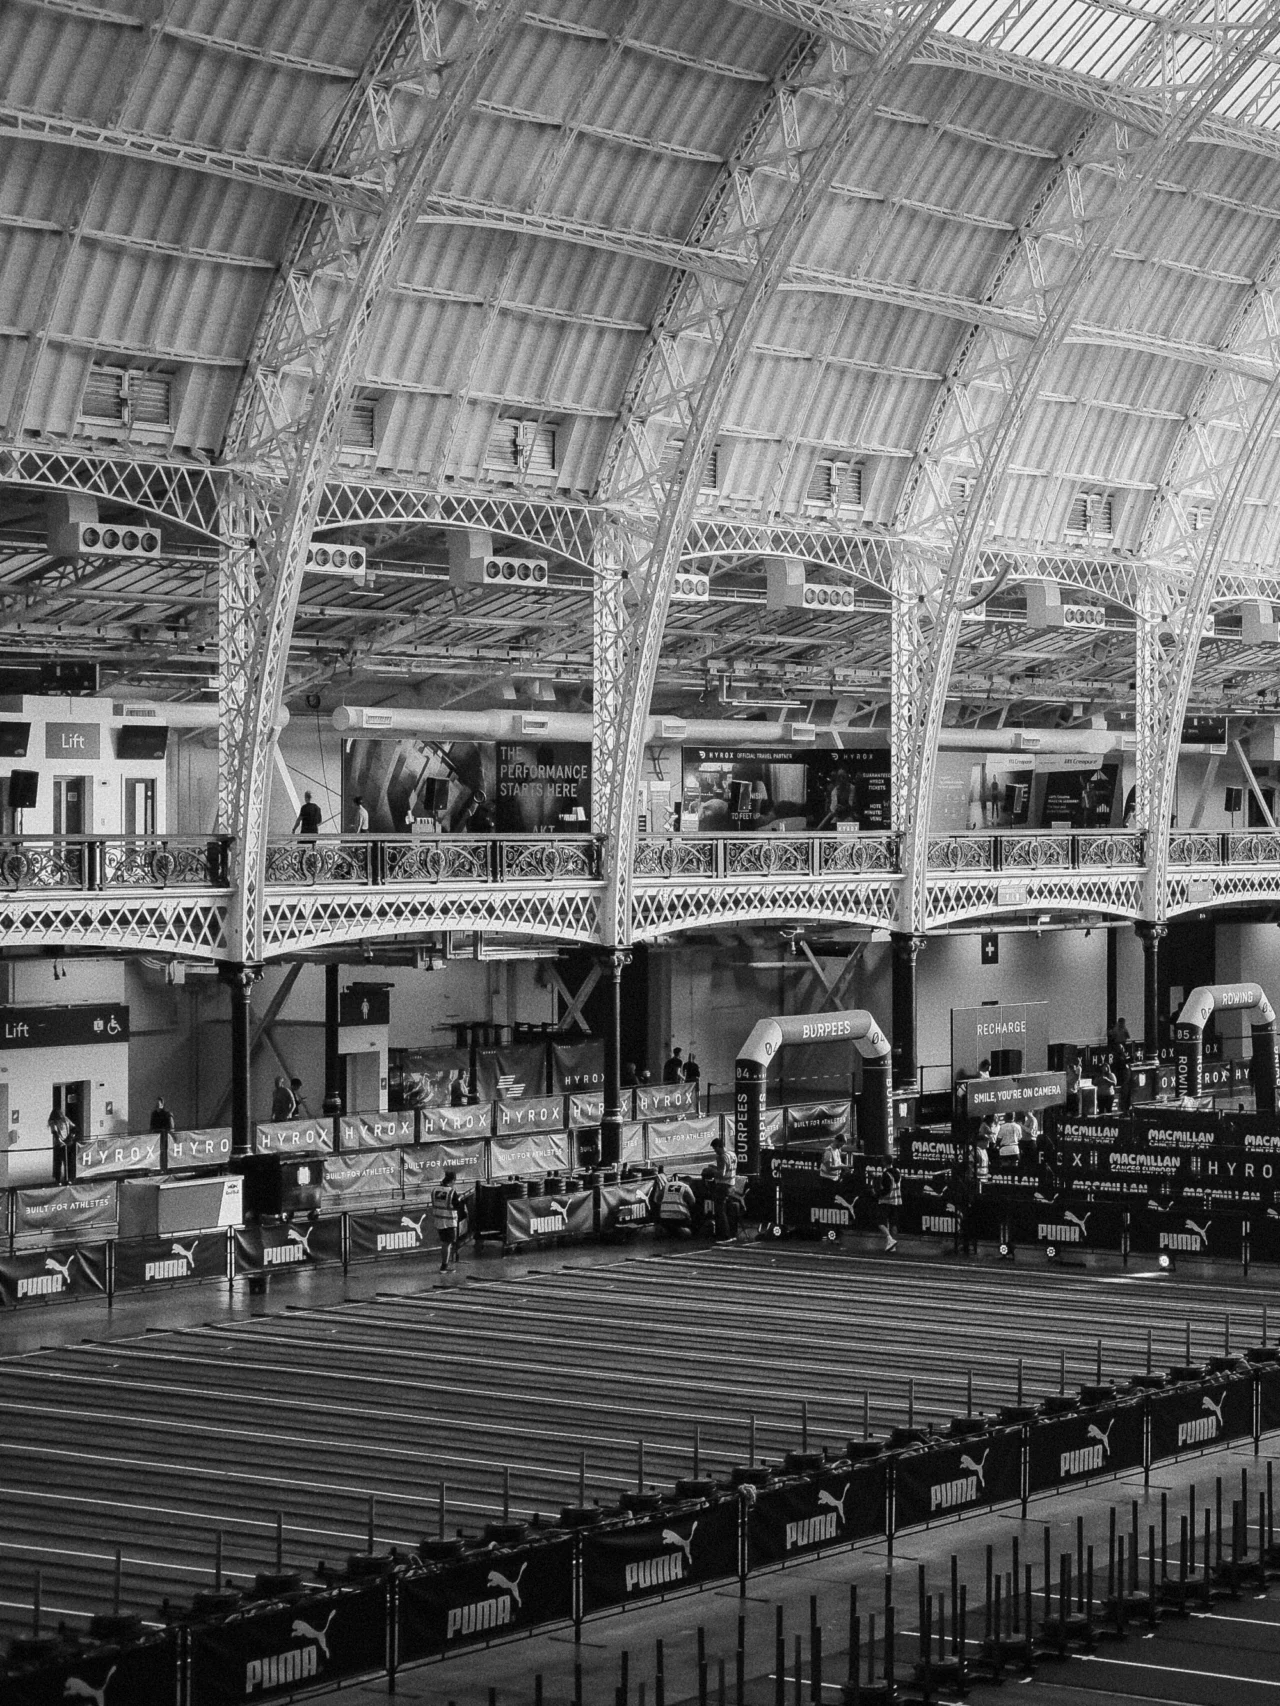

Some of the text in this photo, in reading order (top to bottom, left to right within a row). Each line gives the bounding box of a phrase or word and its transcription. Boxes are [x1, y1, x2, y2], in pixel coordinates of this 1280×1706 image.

[61, 733, 85, 749] Lift
[501, 746, 522, 760] THE
[500, 765, 588, 779] PERFORMANCE
[500, 783, 577, 797] STARTS HERE
[1222, 991, 1253, 1004] ROWING
[6, 1023, 29, 1038] Lift
[802, 1021, 851, 1039] BURPEES
[977, 1021, 1026, 1036] RECHARGE
[1178, 1030, 1189, 1039] 05
[737, 1068, 749, 1078] 04
[641, 1092, 692, 1110] HYROX
[974, 1085, 1061, 1104] SMILE, YOU'RE ON CAMERA
[502, 1107, 560, 1124] HYROX
[573, 1100, 628, 1117] HYRX
[345, 1122, 410, 1139] HYROX
[425, 1114, 487, 1132] HYROX
[738, 1093, 748, 1162] BURPEES
[262, 1129, 328, 1148] HYROX
[1148, 1129, 1214, 1143] MACMILLAN
[82, 1146, 155, 1165] HYROX
[174, 1139, 229, 1156] HYRO
[404, 1158, 478, 1170] BUILT FOR ATHLETES
[1109, 1152, 1180, 1167] MACMILLAN
[326, 1167, 395, 1180] BUILT FOR ATHLETES
[26, 1199, 108, 1214] BUILT FOR ATHLETES
[530, 1215, 562, 1234] PUMA
[811, 1208, 849, 1225] PUMA
[378, 1232, 417, 1251] PUMA
[1039, 1224, 1079, 1242] PUMA
[1160, 1232, 1200, 1251] PUMA
[264, 1245, 304, 1265] PUMA
[146, 1260, 188, 1280] PUMA
[18, 1274, 63, 1298] PUMA
[1178, 1417, 1217, 1447] PUMA
[1060, 1446, 1102, 1478] PUMA
[930, 1477, 977, 1512] PUMA
[786, 1511, 838, 1550] PUMA
[626, 1553, 682, 1592] PUMA
[447, 1595, 510, 1639] PUMA
[246, 1645, 317, 1694] PUMA
